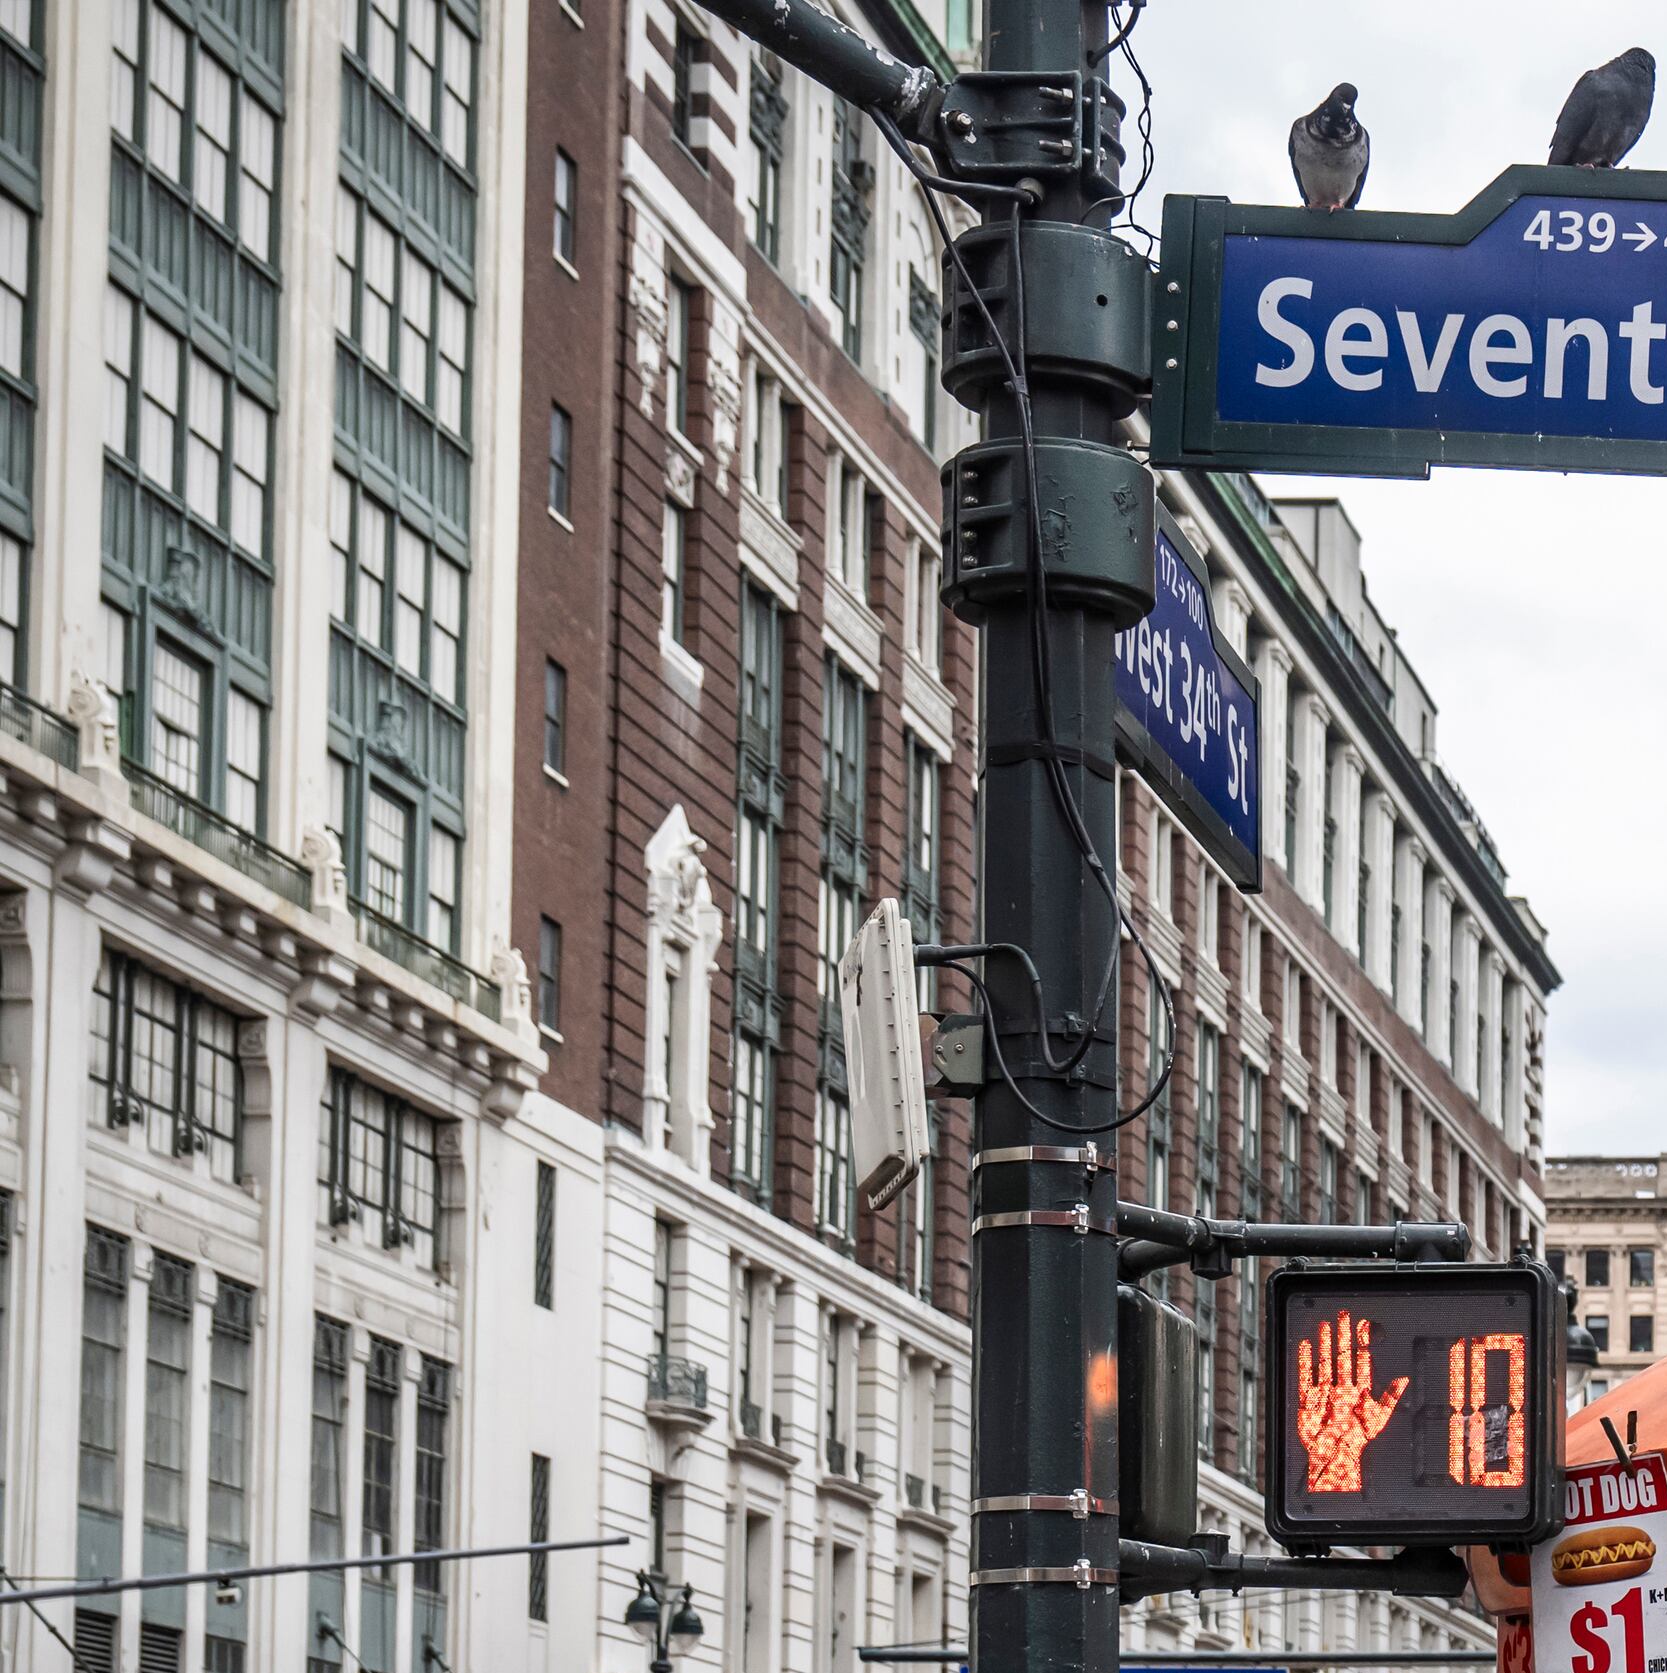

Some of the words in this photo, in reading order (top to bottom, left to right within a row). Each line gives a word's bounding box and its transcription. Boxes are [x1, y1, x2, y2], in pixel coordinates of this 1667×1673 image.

[1523, 210, 1617, 253] 439
[1159, 543, 1179, 597] 172
[1187, 579, 1204, 631] 100
[1180, 640, 1221, 763] 34th
[1226, 703, 1249, 816] St
[1449, 1333, 1526, 1487] 10
[1565, 1478, 1595, 1520] OT
[1601, 1467, 1658, 1515] DOG
